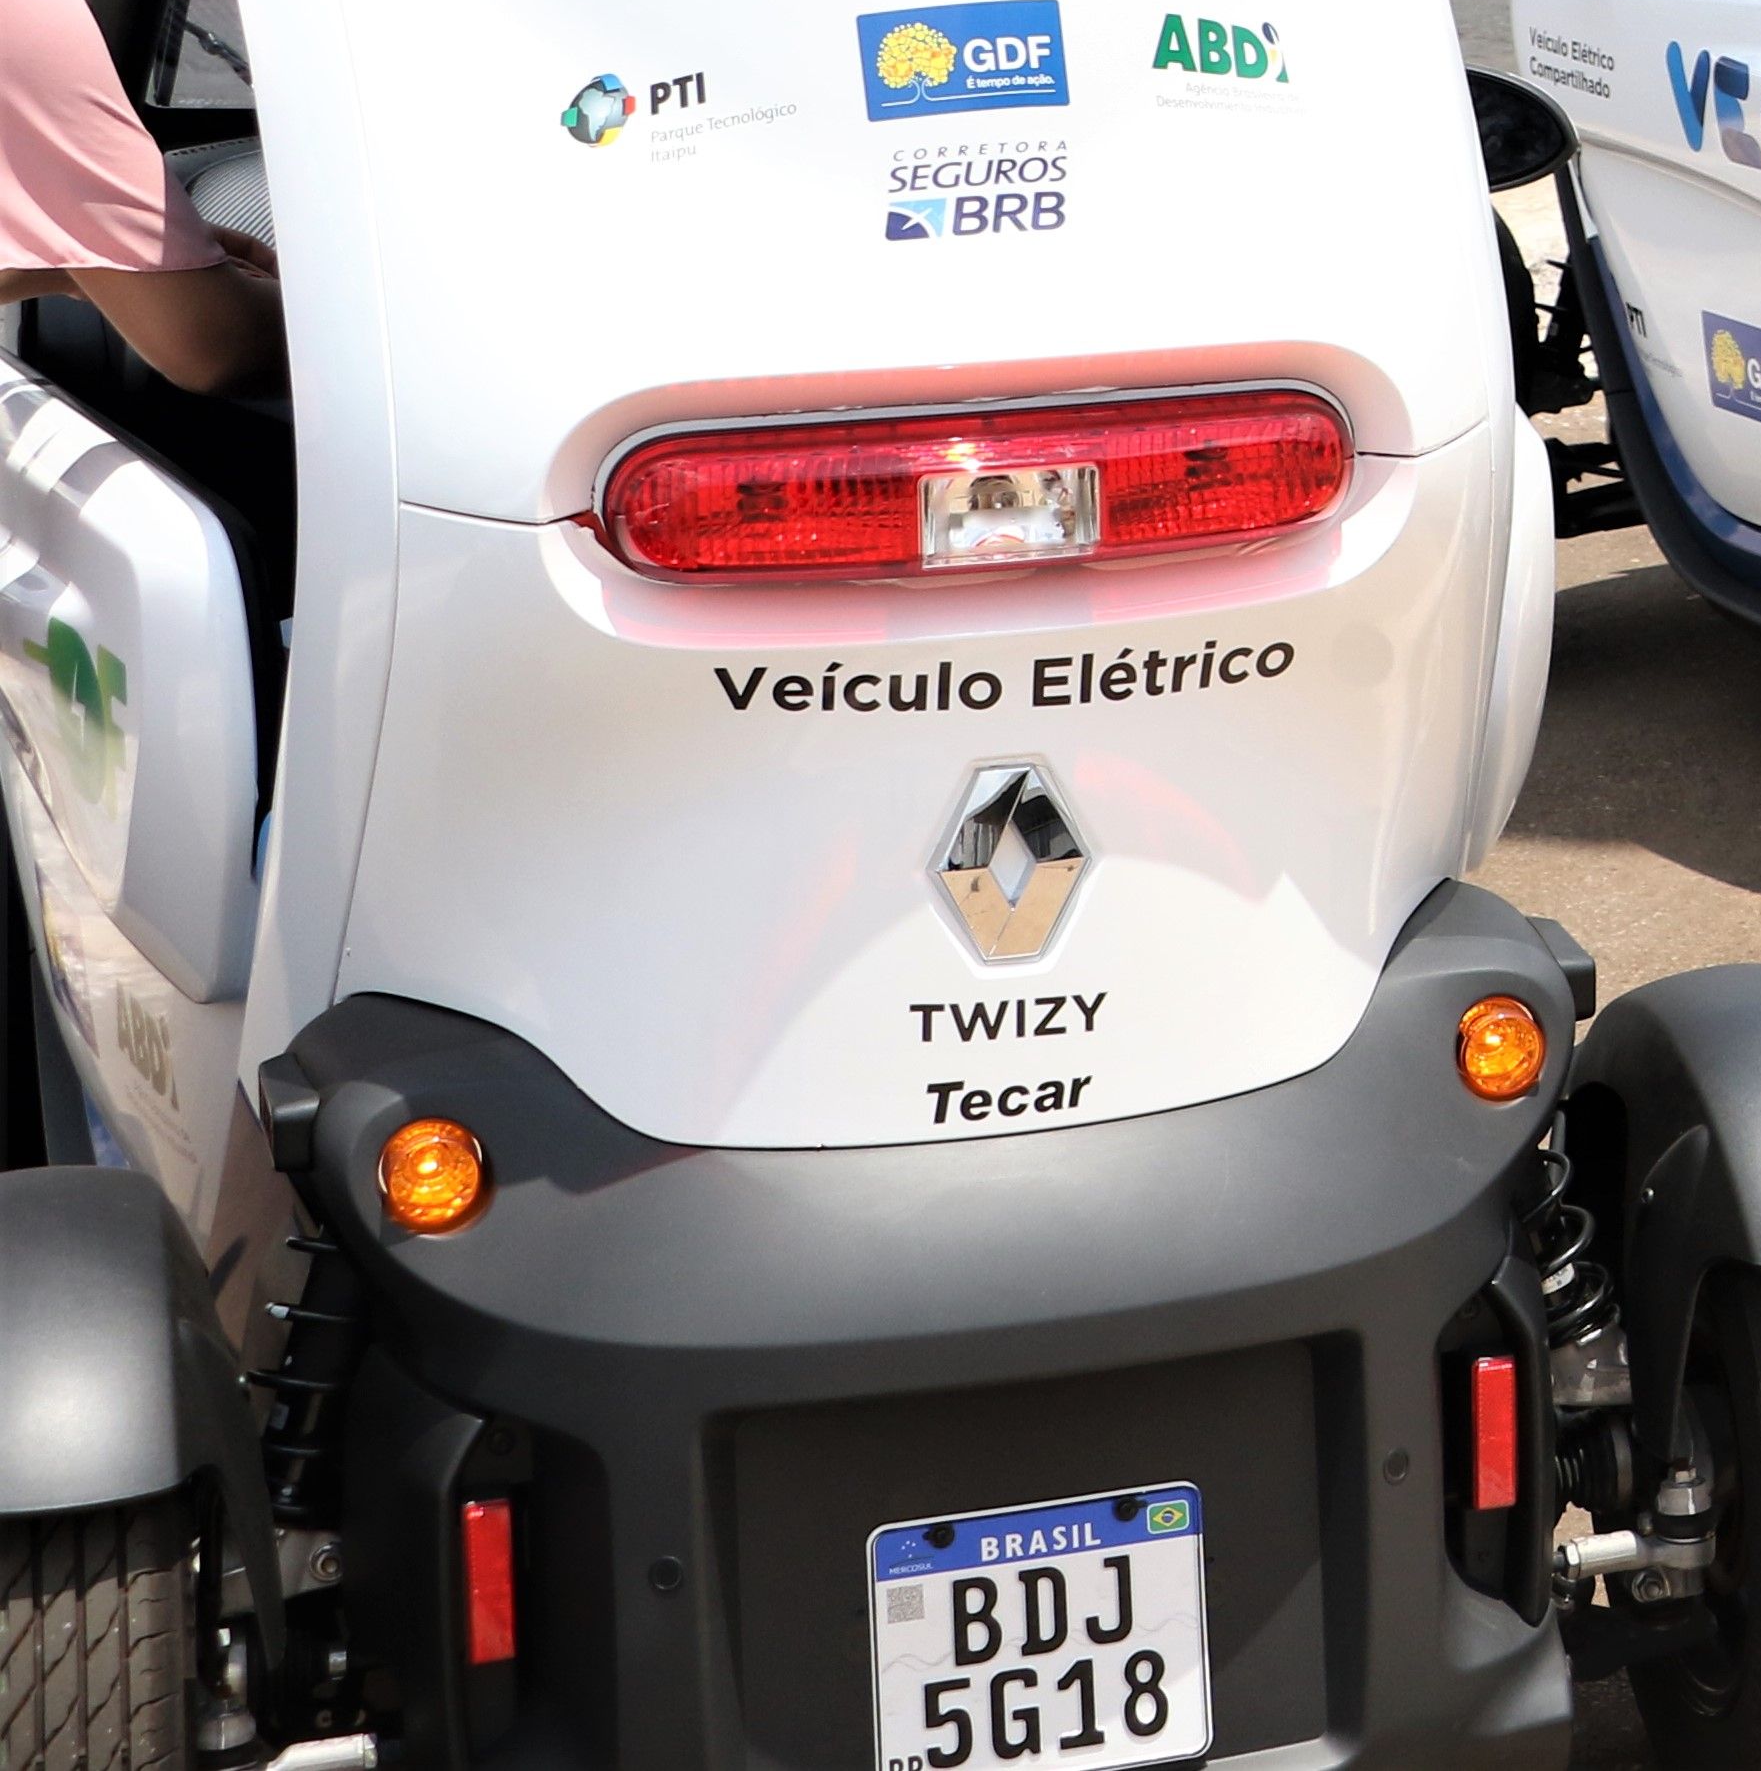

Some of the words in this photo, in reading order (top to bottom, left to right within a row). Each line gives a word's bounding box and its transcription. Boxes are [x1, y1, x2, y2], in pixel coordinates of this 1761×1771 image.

[963, 35, 1051, 73] GDF
[1529, 26, 1568, 58] Veículo
[1571, 40, 1615, 72] Elétrico
[649, 72, 707, 116] PTI
[977, 76, 1010, 89] tempo
[1012, 75, 1026, 86] de
[1529, 55, 1611, 99] Compartilhado
[651, 123, 704, 143] Parque
[706, 102, 798, 131] Tecnológico
[651, 144, 697, 163] Itaipu
[893, 140, 1069, 162] CORRETORA
[888, 155, 1068, 194] SEGUROS
[951, 191, 1067, 238] BRB
[715, 661, 1003, 712] Veículo
[1032, 640, 1295, 707] Elétrico
[909, 992, 1108, 1043] TWIZY
[926, 1076, 1093, 1124] Tecar
[980, 1523, 1101, 1562] BRASIL
[952, 1554, 1133, 1666] BDJ
[924, 1649, 1169, 1769] 5G18
